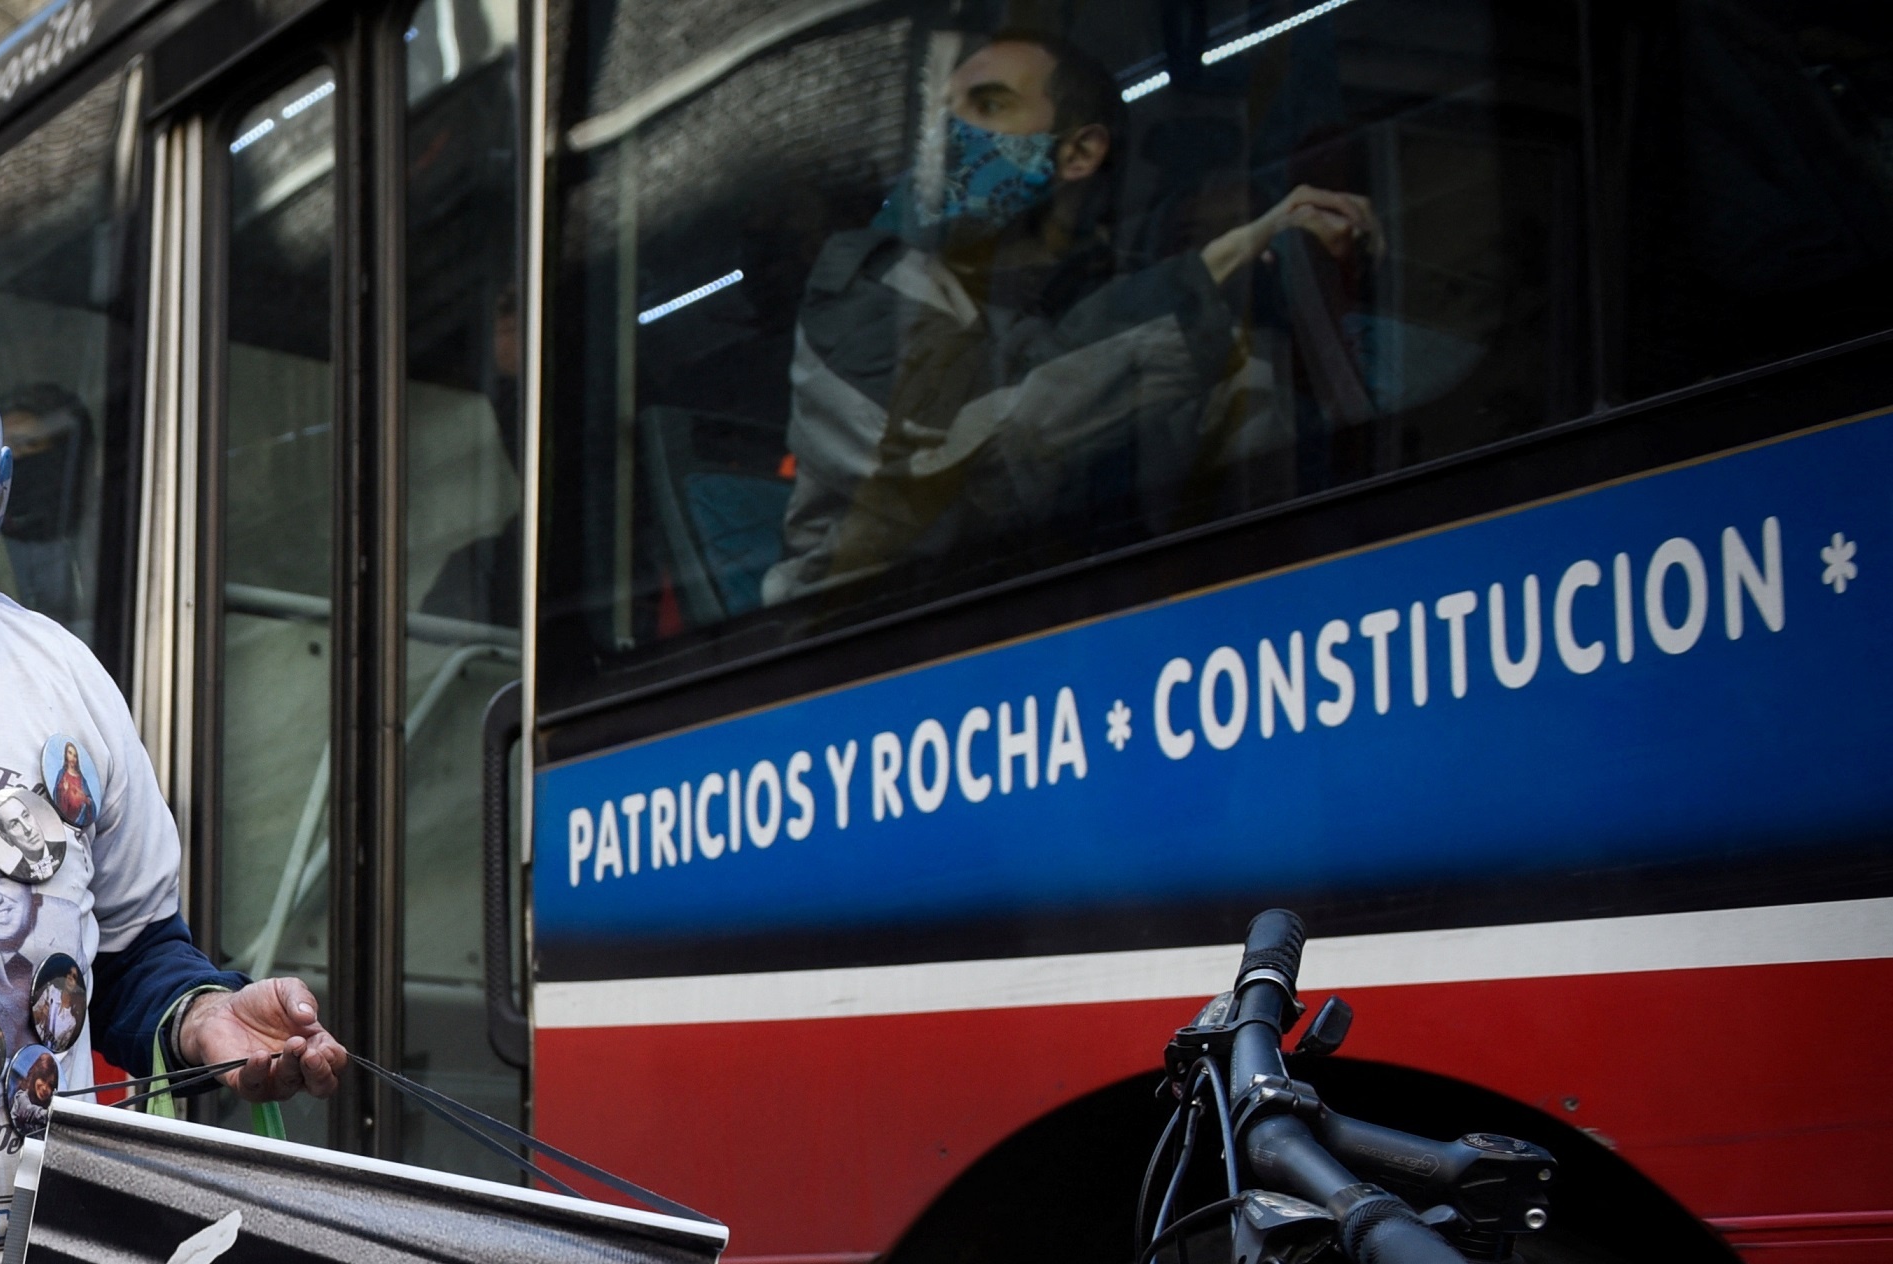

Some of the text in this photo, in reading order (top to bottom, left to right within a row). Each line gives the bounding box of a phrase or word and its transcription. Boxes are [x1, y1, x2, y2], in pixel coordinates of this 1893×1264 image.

[568, 515, 1786, 888] PATRICIOS Y ROCHA CONSTITUCION
